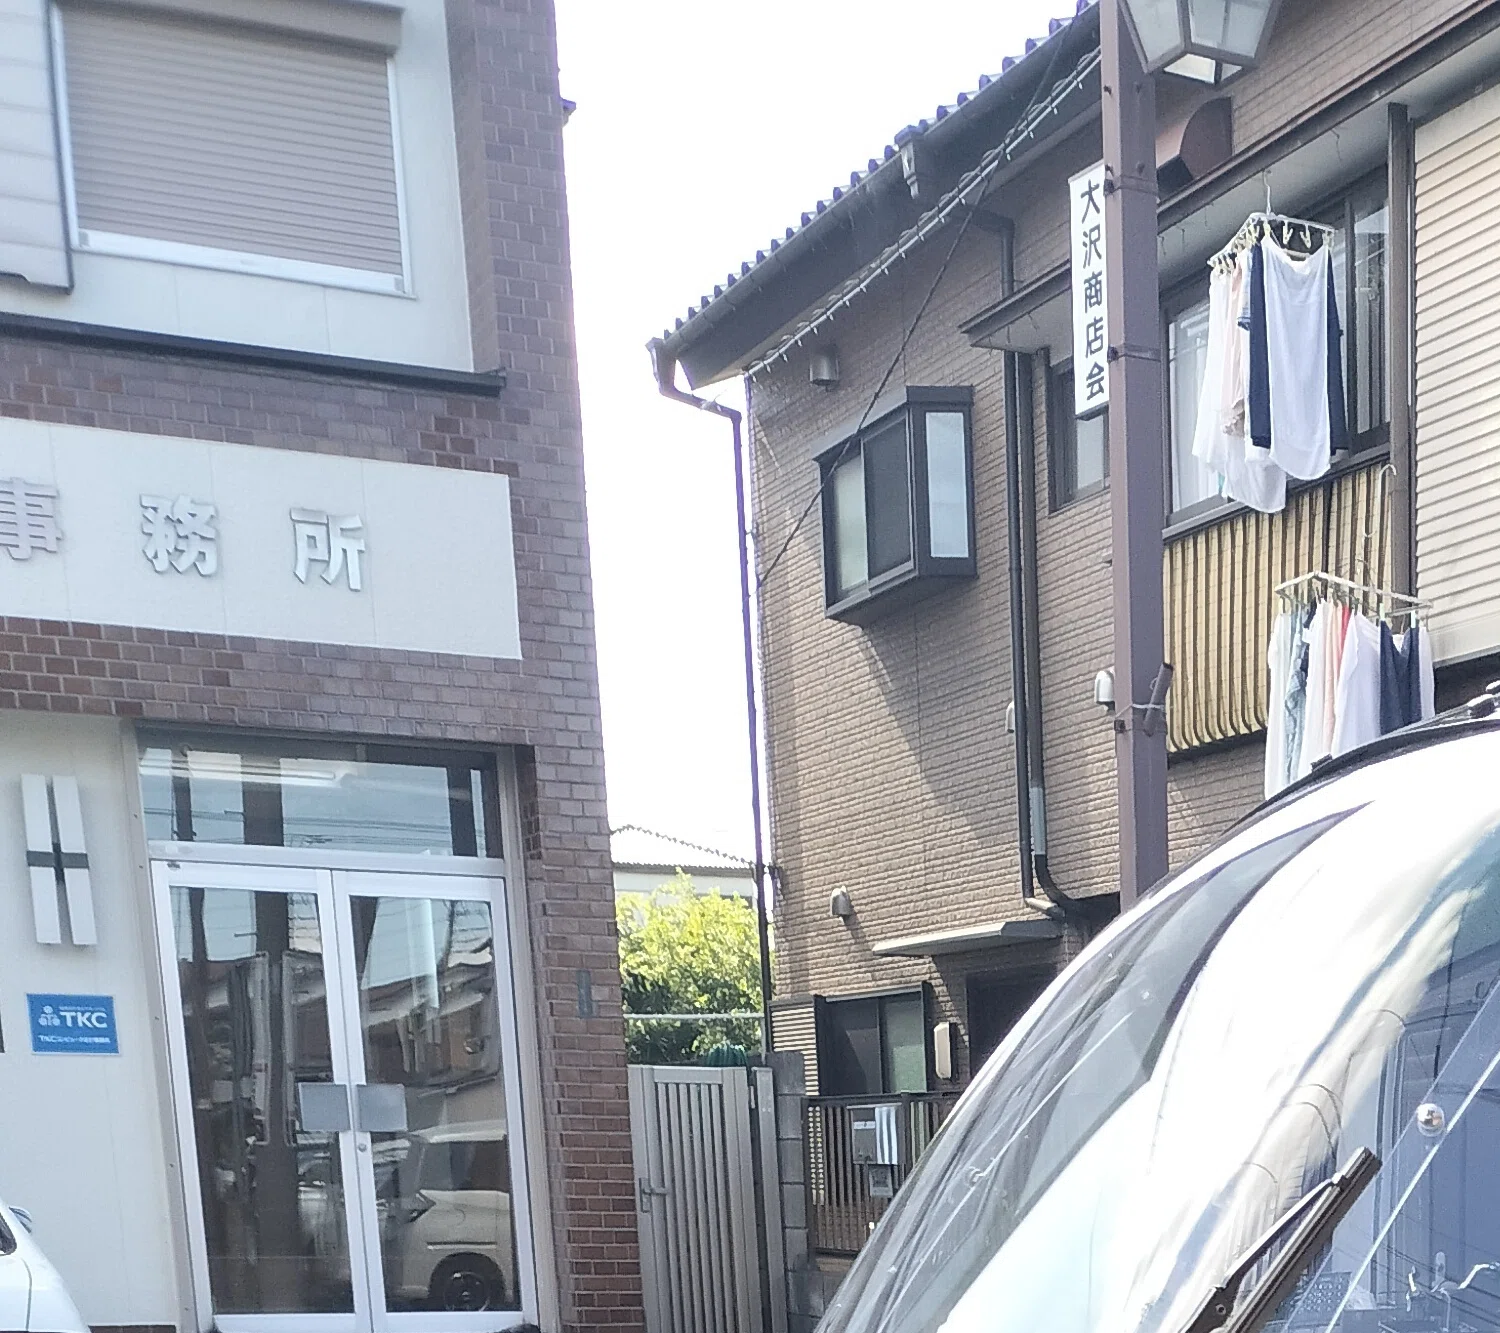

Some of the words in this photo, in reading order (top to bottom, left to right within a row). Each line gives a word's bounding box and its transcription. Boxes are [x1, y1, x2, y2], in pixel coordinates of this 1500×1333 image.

[1080, 178, 1105, 401] 大沢商店会
[0, 476, 366, 592] 事務所
[59, 1011, 108, 1028] TKC
